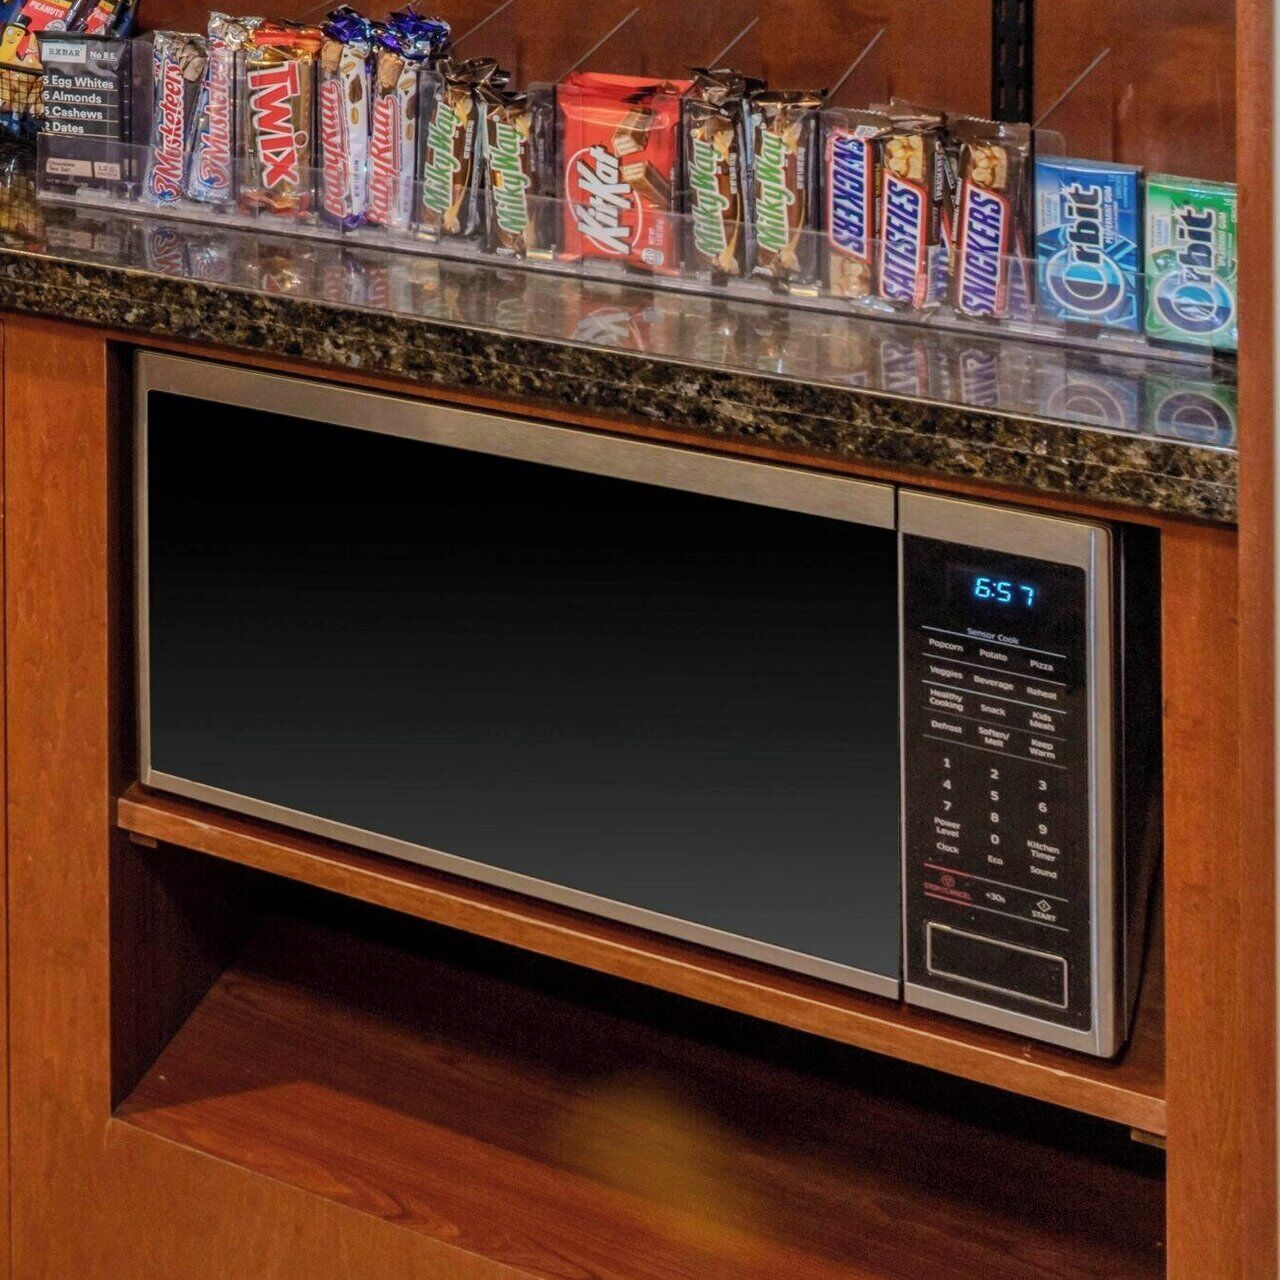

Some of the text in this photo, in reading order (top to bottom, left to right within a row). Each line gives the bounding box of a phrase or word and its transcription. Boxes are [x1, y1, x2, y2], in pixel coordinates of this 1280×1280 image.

[28, 0, 65, 18] PEANUTS
[48, 48, 102, 59] RXBAR No
[43, 75, 114, 89] 3 Egg Whites
[43, 90, 102, 104] 6 Almonds
[44, 106, 103, 120] 5 Cashews
[44, 122, 84, 133] 2 Dates
[151, 59, 184, 202] 3 Musketeers
[199, 156, 230, 188] 3
[832, 136, 865, 256] SNICKERS
[1104, 186, 1114, 204] GUM
[1218, 212, 1227, 234] GUM
[883, 179, 920, 302] SATISFIES
[962, 189, 1002, 314] SNICKERS
[1045, 182, 1124, 315] Orbit
[1154, 205, 1236, 335] Orbit
[975, 577, 1035, 607] 6:57
[966, 627, 1020, 645] Sensor Cook
[928, 638, 964, 653] Popcorn
[979, 648, 1008, 662] Potato
[929, 665, 964, 680] Veggies
[1029, 659, 1054, 672] Pizza
[973, 674, 1015, 691] Beverage
[929, 688, 964, 703] Healthy
[1026, 686, 1057, 701] Reheat
[929, 697, 964, 713] Cooking
[980, 703, 1006, 717] Snack
[1032, 711, 1052, 723] Kids
[930, 719, 962, 734] Defrost
[1029, 719, 1056, 732] Meals
[978, 726, 1011, 741] Soften/
[983, 736, 1005, 748] Melt
[1030, 738, 1054, 751] Keep
[1028, 746, 1057, 760] Warm
[943, 758, 951, 768] 1
[990, 769, 999, 780] 2
[942, 779, 952, 790] 4
[1038, 780, 1048, 791] 3
[990, 790, 999, 801] 5
[943, 800, 952, 811] 7
[1038, 802, 1048, 813] 6
[934, 816, 961, 830] Power
[990, 812, 1000, 823] 8
[936, 827, 960, 838] Level
[1038, 824, 1048, 835] 9
[990, 834, 1000, 845] 0
[936, 842, 960, 854] Clock
[1027, 840, 1061, 855] Kitchen
[987, 854, 1004, 866] Eco
[1031, 849, 1056, 862] Timer
[1029, 865, 1058, 879] Sound
[985, 891, 1006, 904] +30s
[1031, 909, 1057, 922] START
